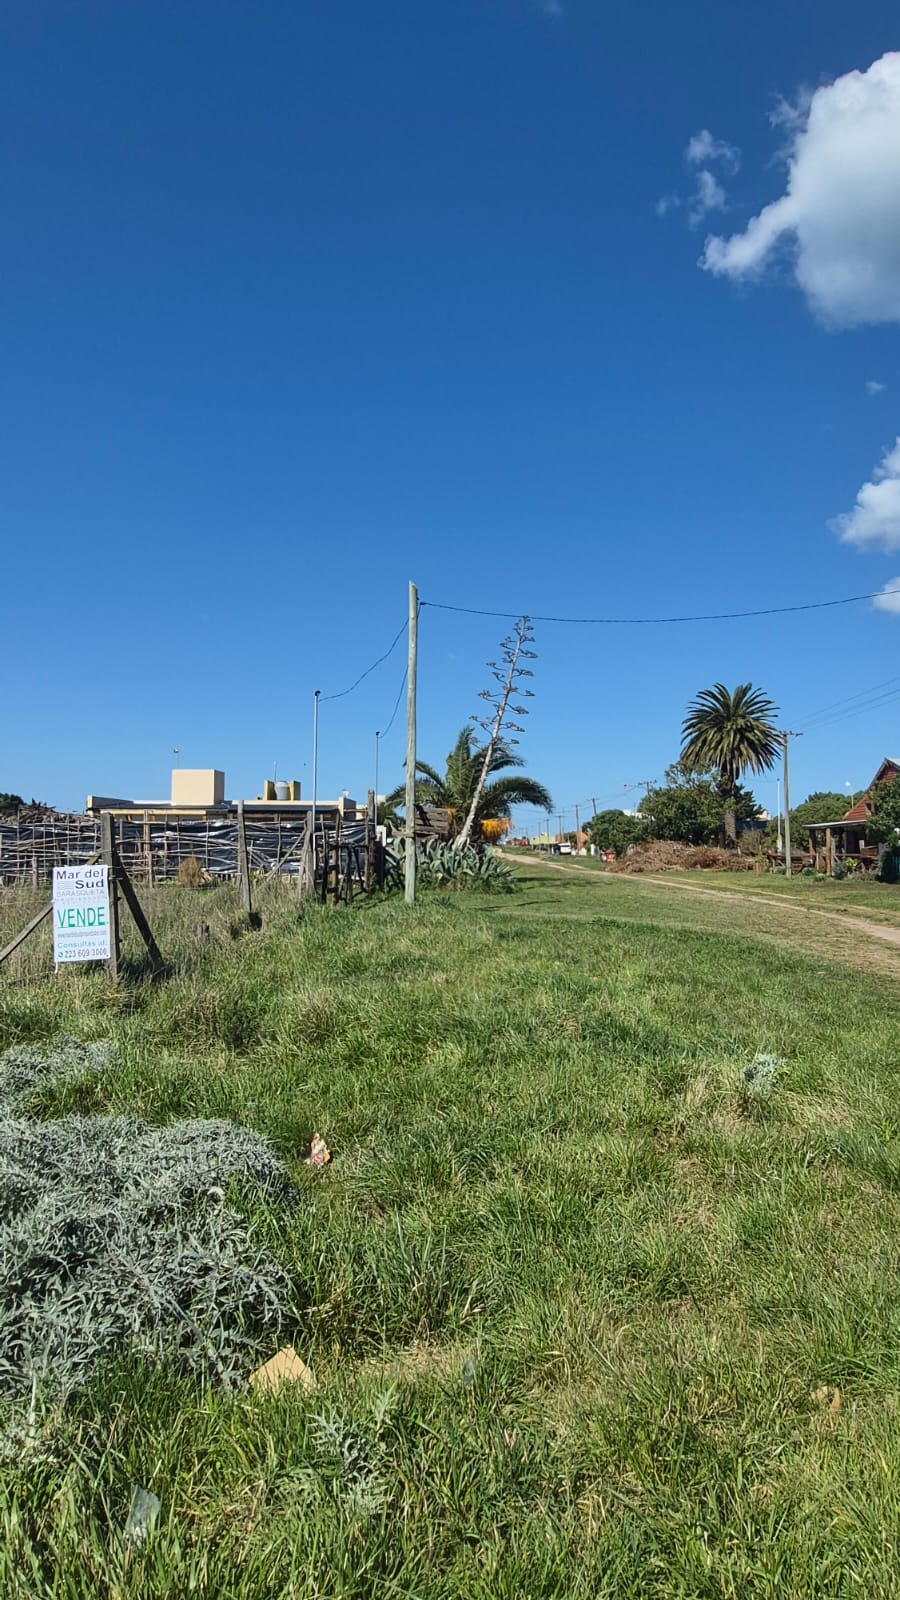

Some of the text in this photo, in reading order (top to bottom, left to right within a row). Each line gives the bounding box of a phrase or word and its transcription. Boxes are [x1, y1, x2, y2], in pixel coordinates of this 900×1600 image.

[57, 868, 104, 880] Mar del
[75, 880, 104, 889] Sud
[57, 907, 105, 928] VENDE
